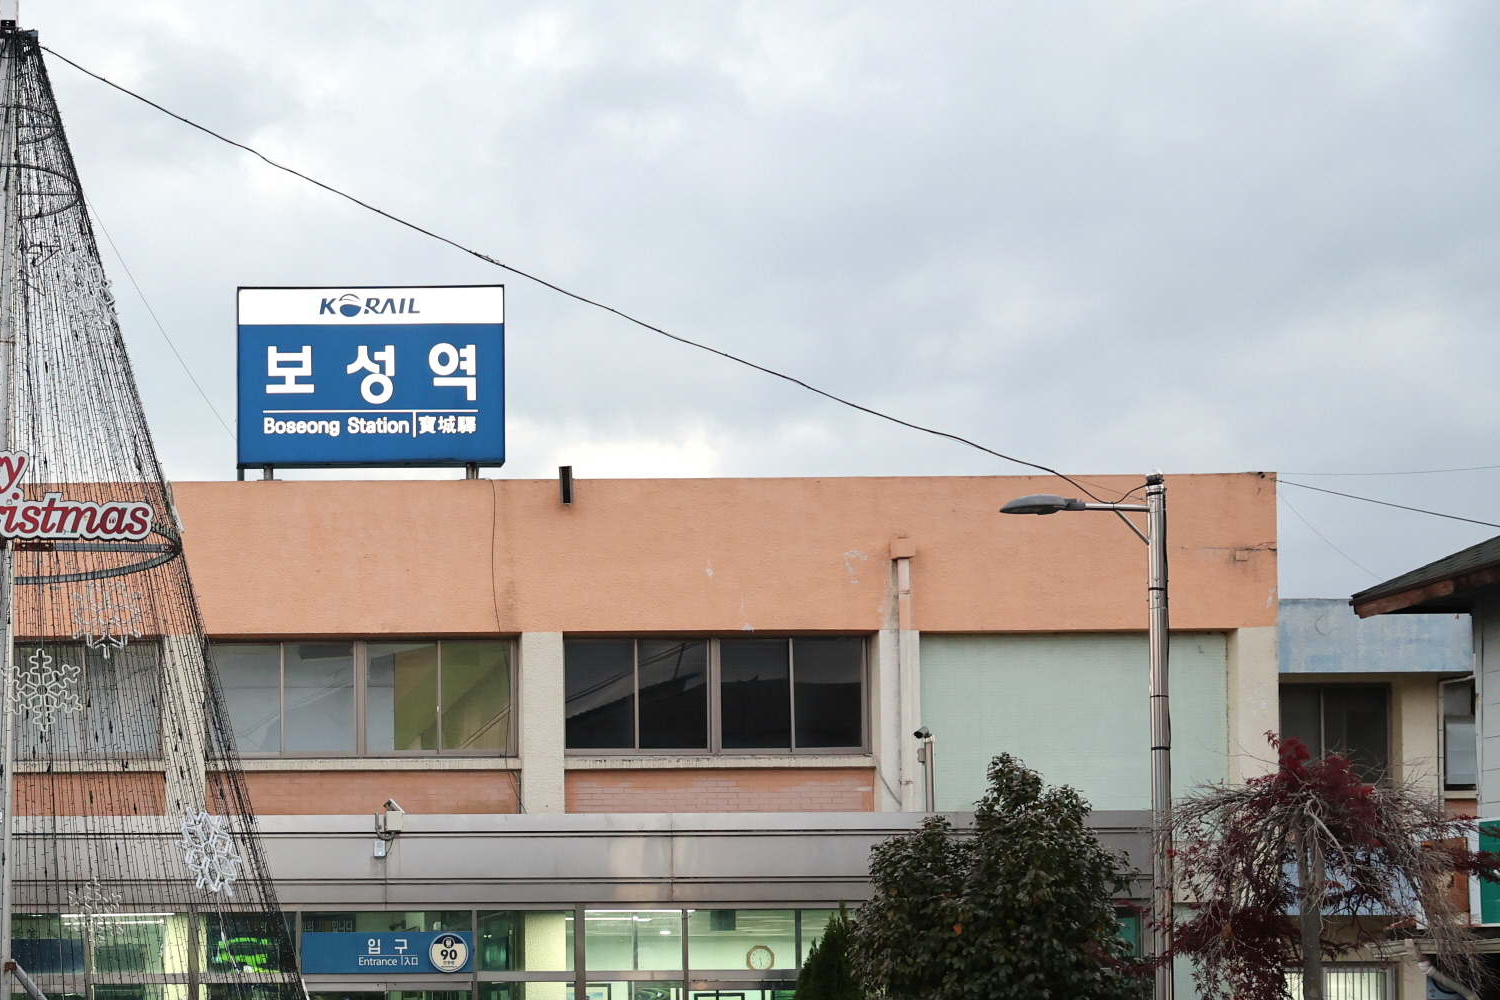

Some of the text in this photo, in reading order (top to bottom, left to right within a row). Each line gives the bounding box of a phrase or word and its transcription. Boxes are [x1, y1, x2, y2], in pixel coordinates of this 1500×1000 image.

[319, 293, 421, 318] KORAIL
[263, 416, 341, 437] Boseong
[347, 415, 410, 435] Station
[367, 938, 408, 955] 입구
[440, 949, 458, 960] 90
[358, 956, 398, 966] Entrance
